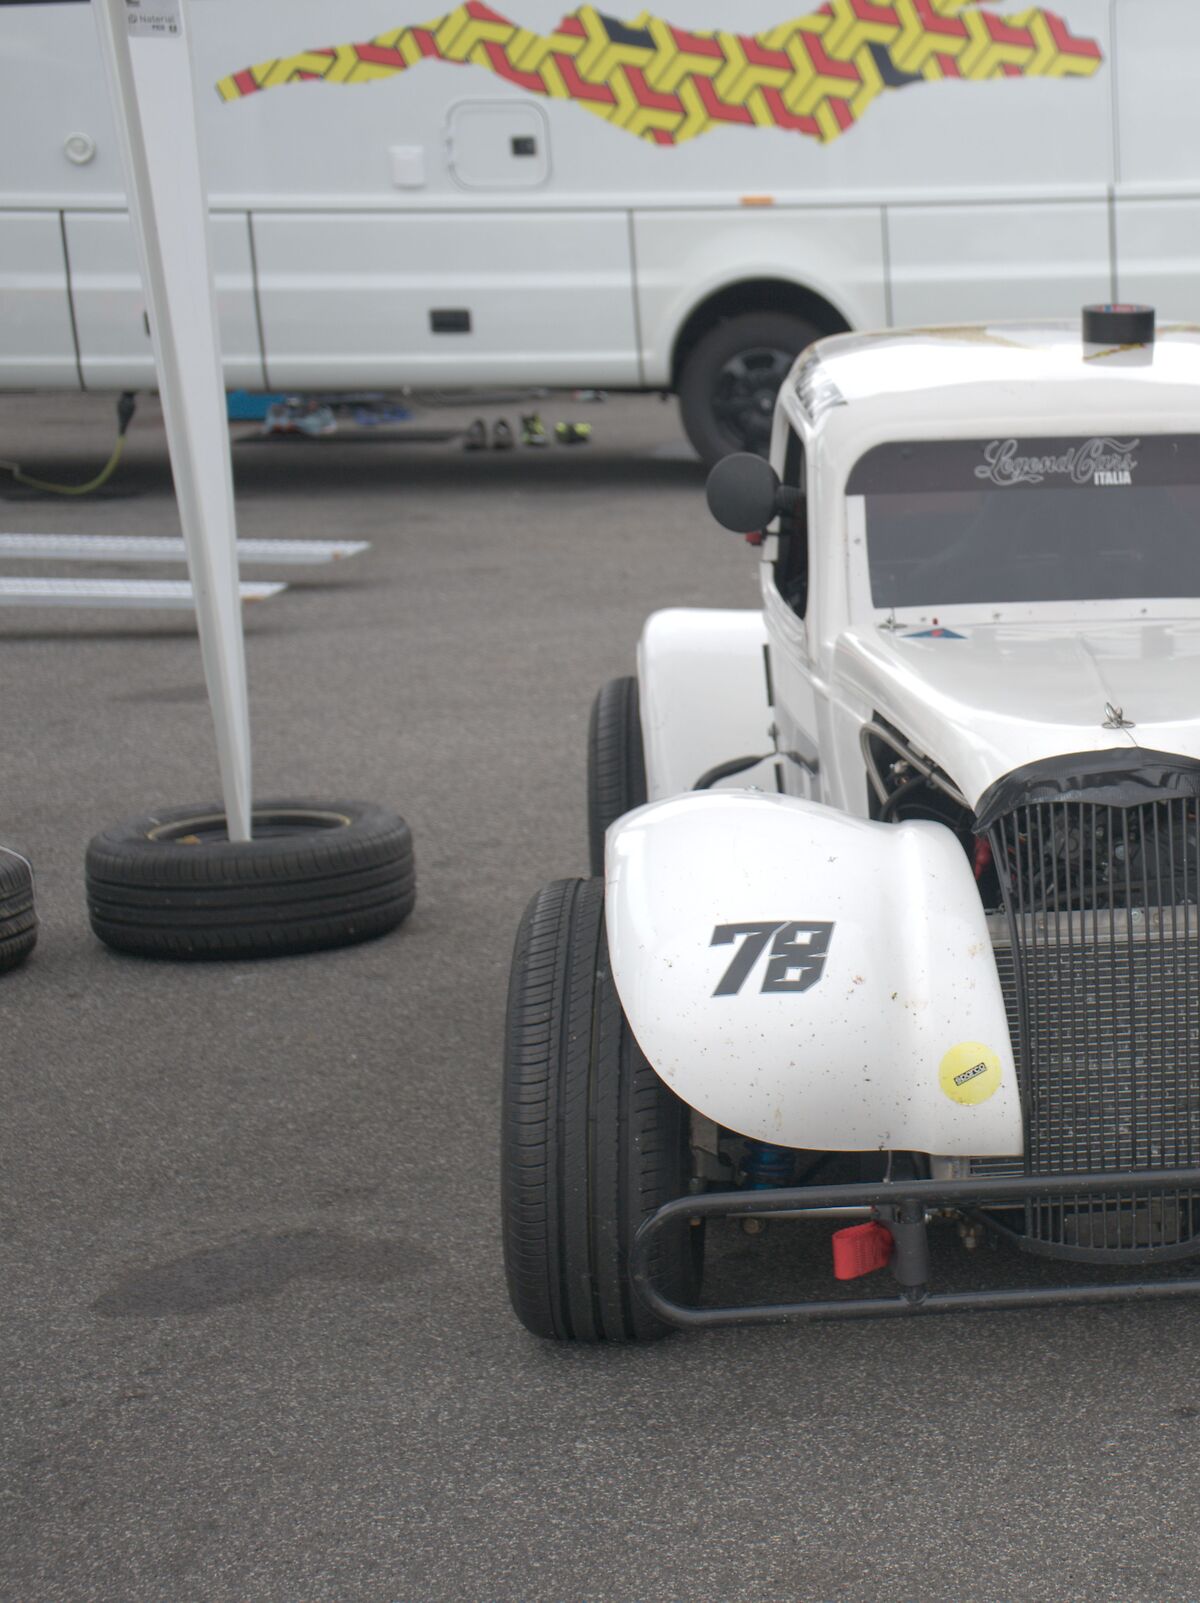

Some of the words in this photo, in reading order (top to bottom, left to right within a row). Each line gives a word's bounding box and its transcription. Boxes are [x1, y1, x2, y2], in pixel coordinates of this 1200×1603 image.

[974, 439, 1075, 486] Legend
[1071, 437, 1140, 484] Cars
[1094, 470, 1132, 486] ITALIA
[709, 920, 836, 998] 78
